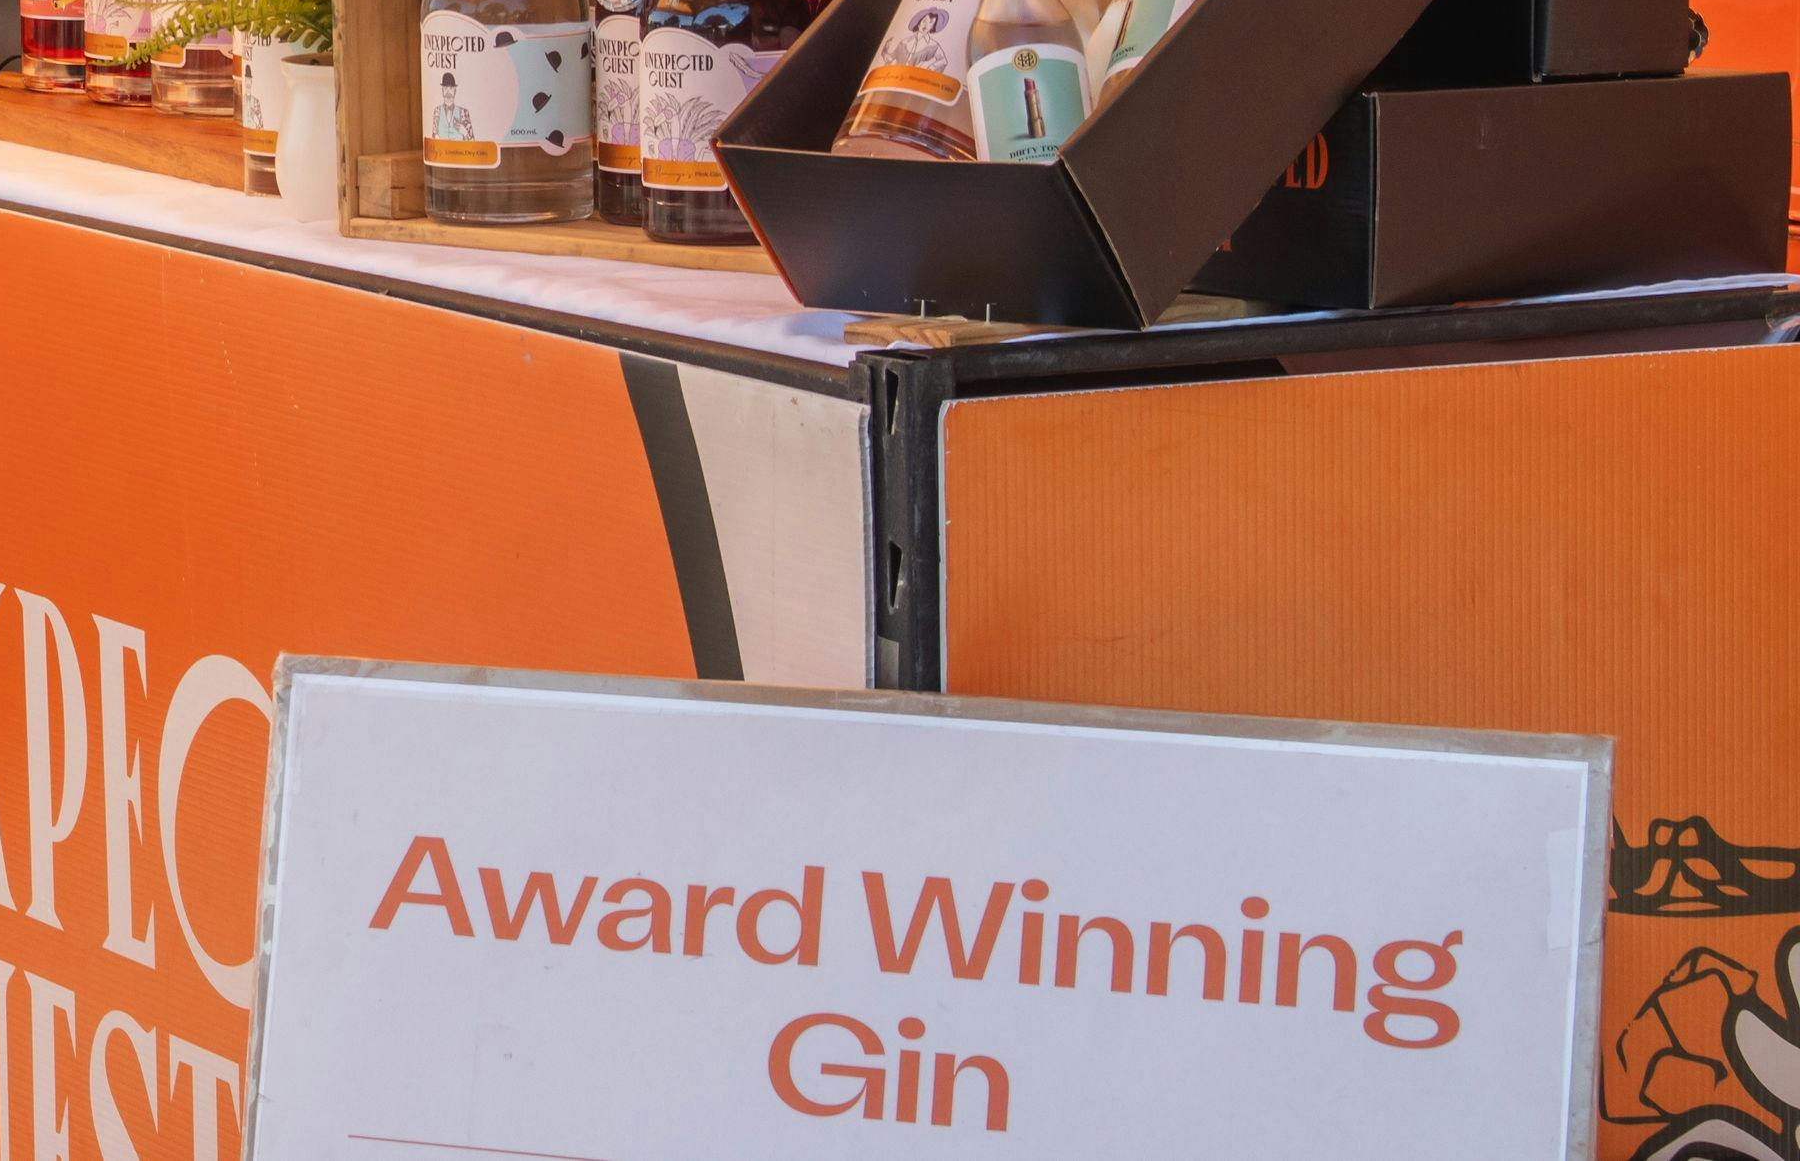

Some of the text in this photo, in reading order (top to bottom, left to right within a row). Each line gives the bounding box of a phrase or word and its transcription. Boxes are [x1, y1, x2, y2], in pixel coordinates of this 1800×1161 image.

[425, 34, 485, 53] UNEXPECTED
[427, 52, 458, 69] GUEST
[602, 57, 635, 74] GUEST
[645, 52, 714, 71] UNEXPECTED
[648, 70, 684, 88] GUEST
[1009, 145, 1039, 159] DIRTY
[368, 833, 1464, 1051] Award Winning
[766, 1011, 1011, 1134] Gin
